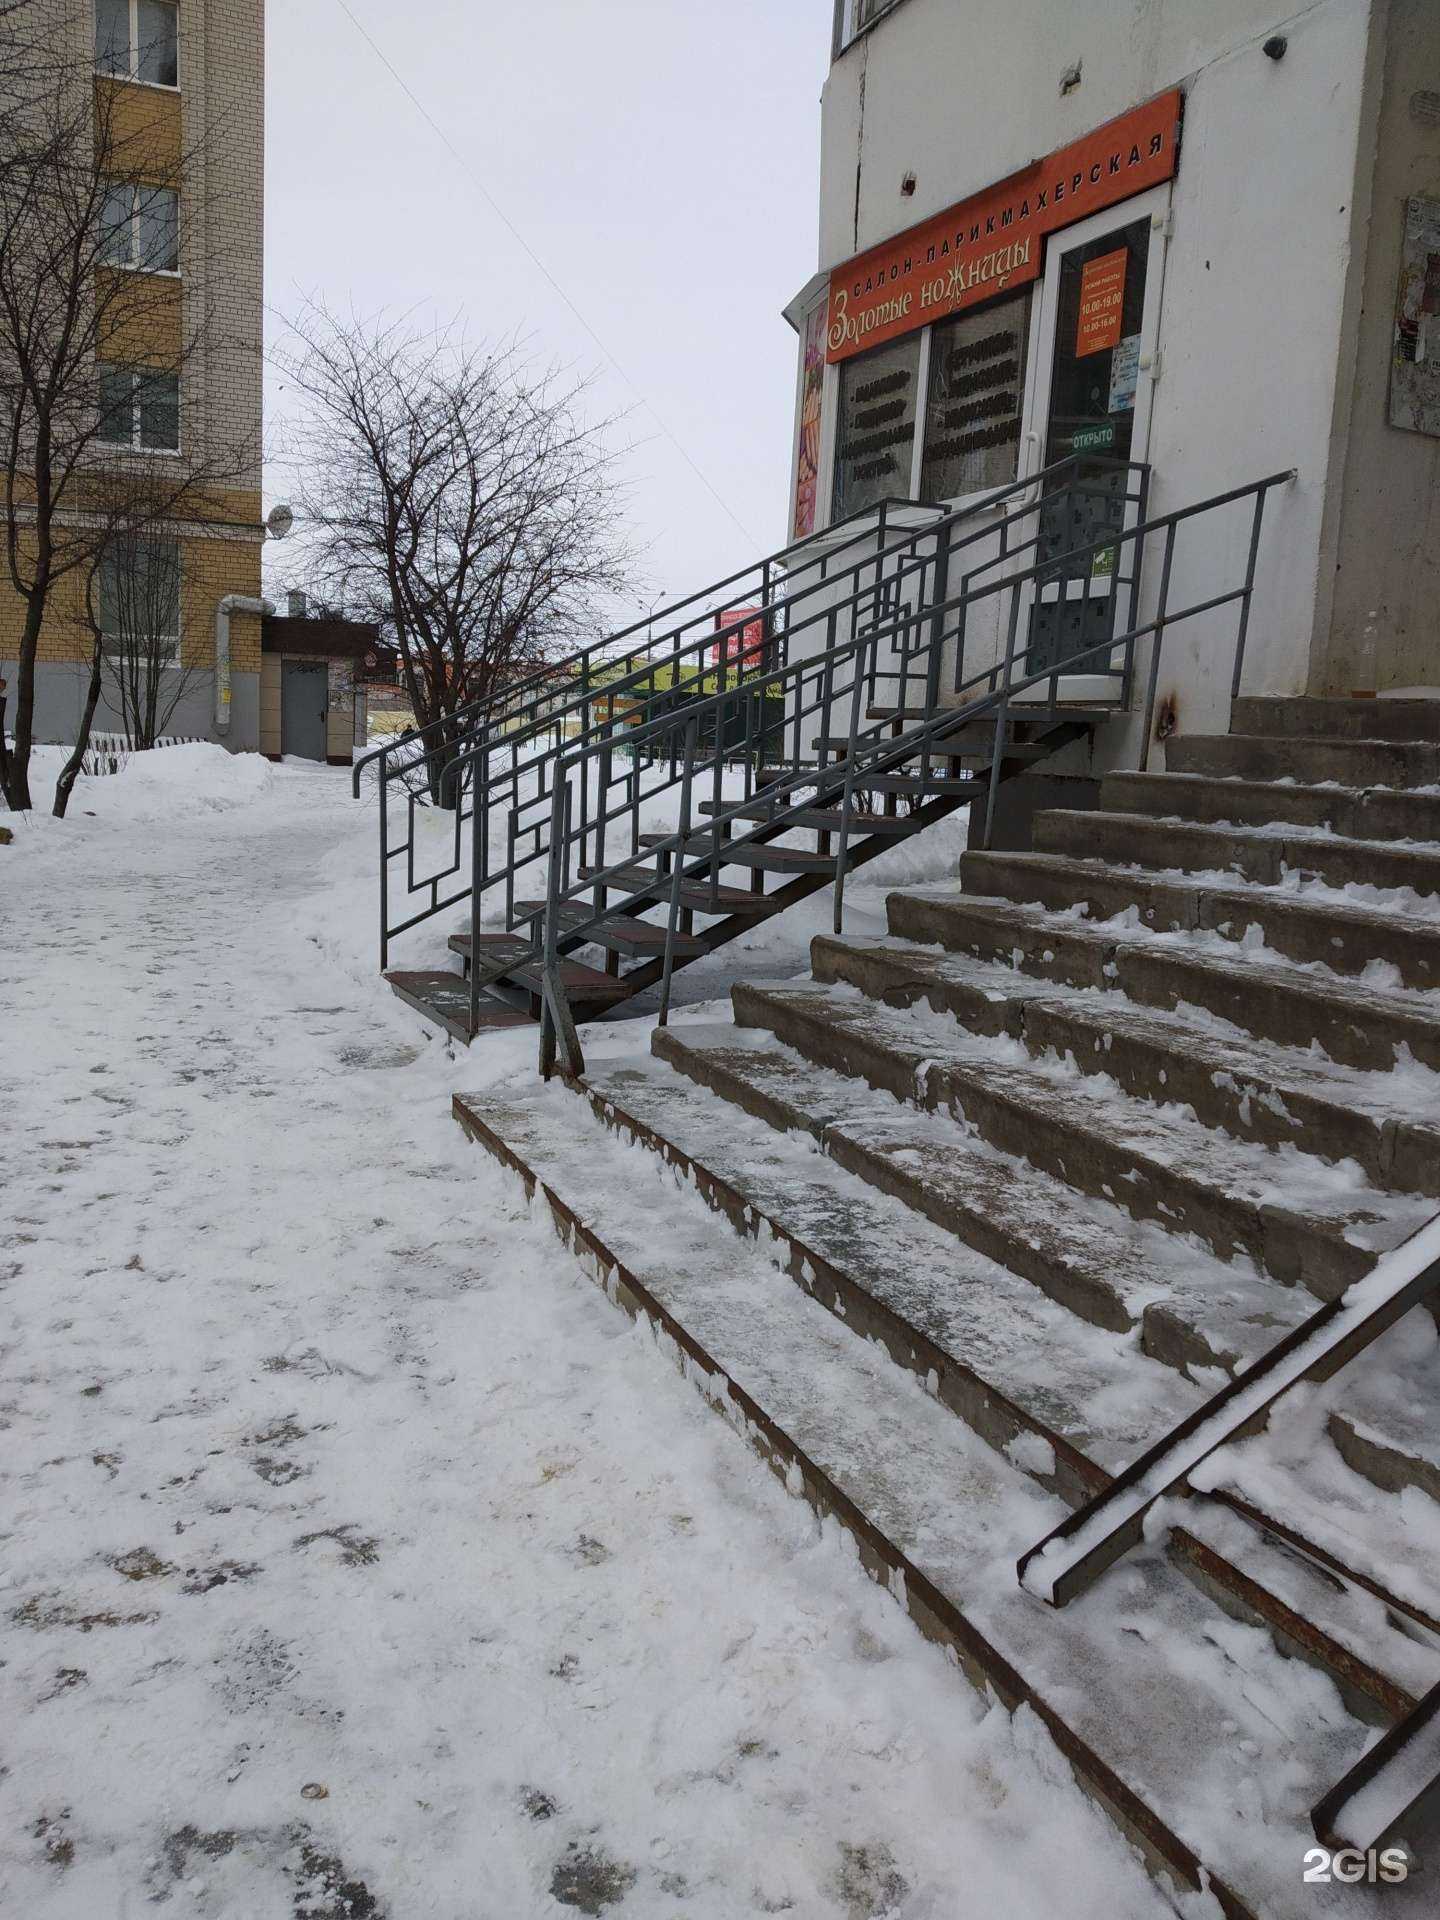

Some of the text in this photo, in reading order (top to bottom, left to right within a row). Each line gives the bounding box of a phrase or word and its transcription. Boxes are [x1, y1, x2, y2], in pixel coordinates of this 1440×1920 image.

[853, 133, 1164, 298] САЛОН-ПАРИКМАХЕРСКАЯ
[827, 289, 913, 351] Золотые
[1073, 428, 1113, 449] ОТКРЫТО
